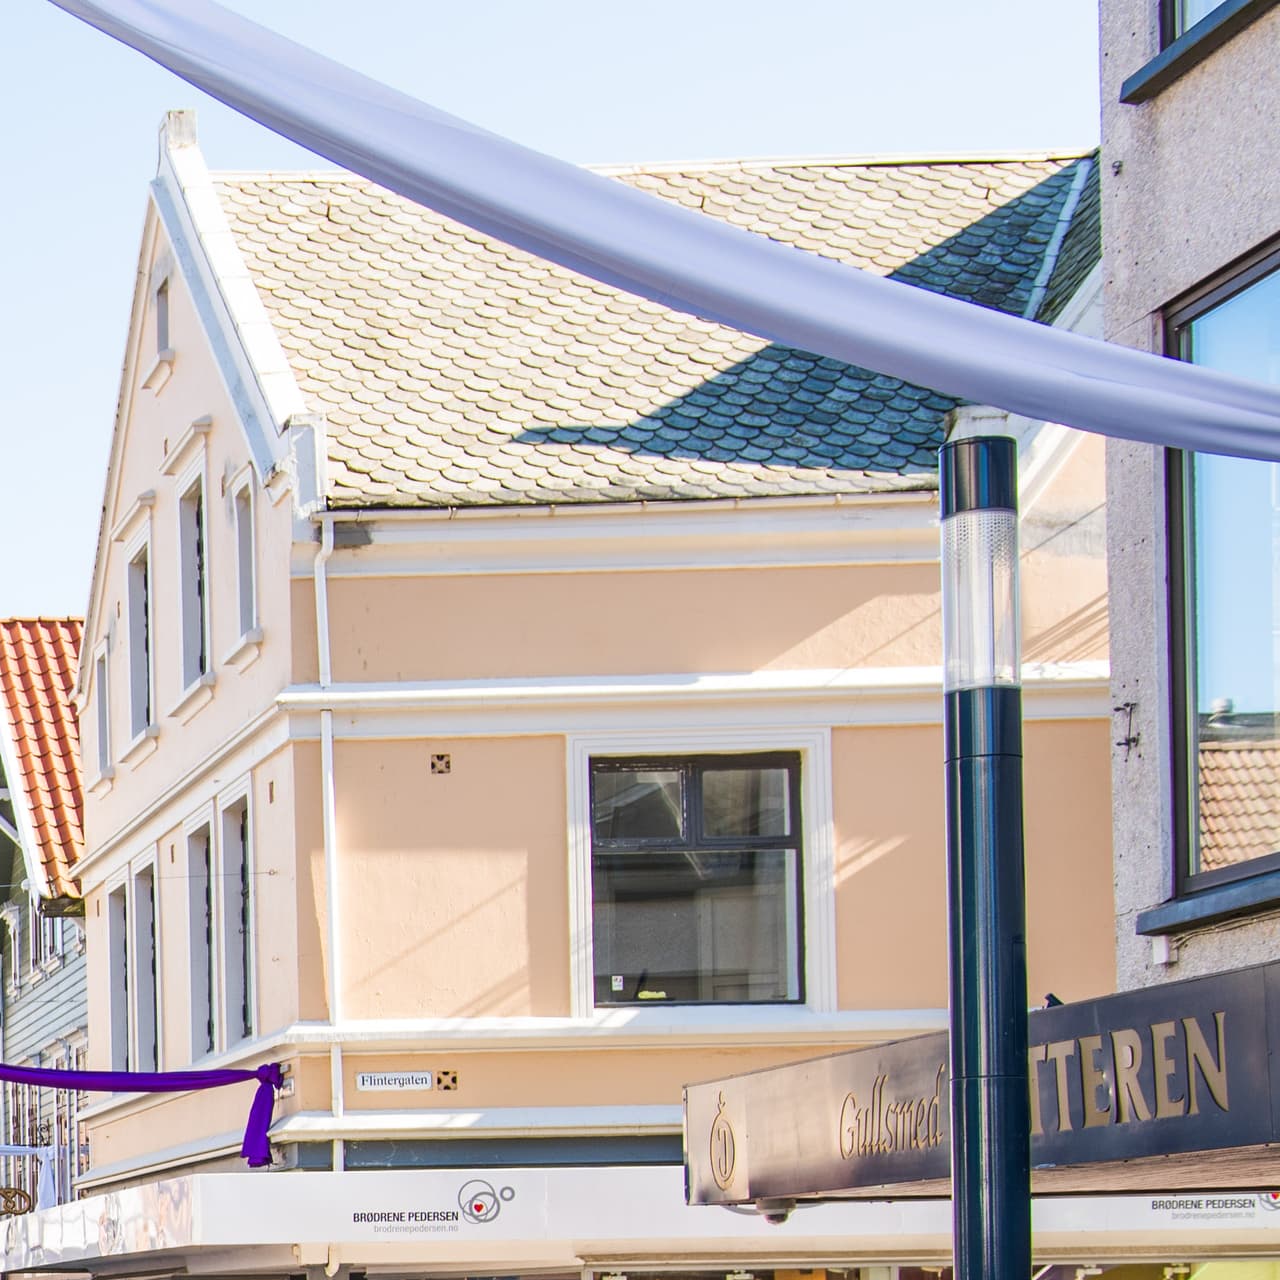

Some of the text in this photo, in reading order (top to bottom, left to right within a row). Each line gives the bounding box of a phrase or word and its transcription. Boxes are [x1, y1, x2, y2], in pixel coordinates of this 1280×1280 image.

[361, 1075, 428, 1088] Flintergaten
[840, 1011, 1230, 1160] Gullsmed TTEREN
[1151, 1199, 1255, 1210] BRØDRENE PEDERSEN
[353, 1211, 459, 1223] BRØDRENE PEDERSEN
